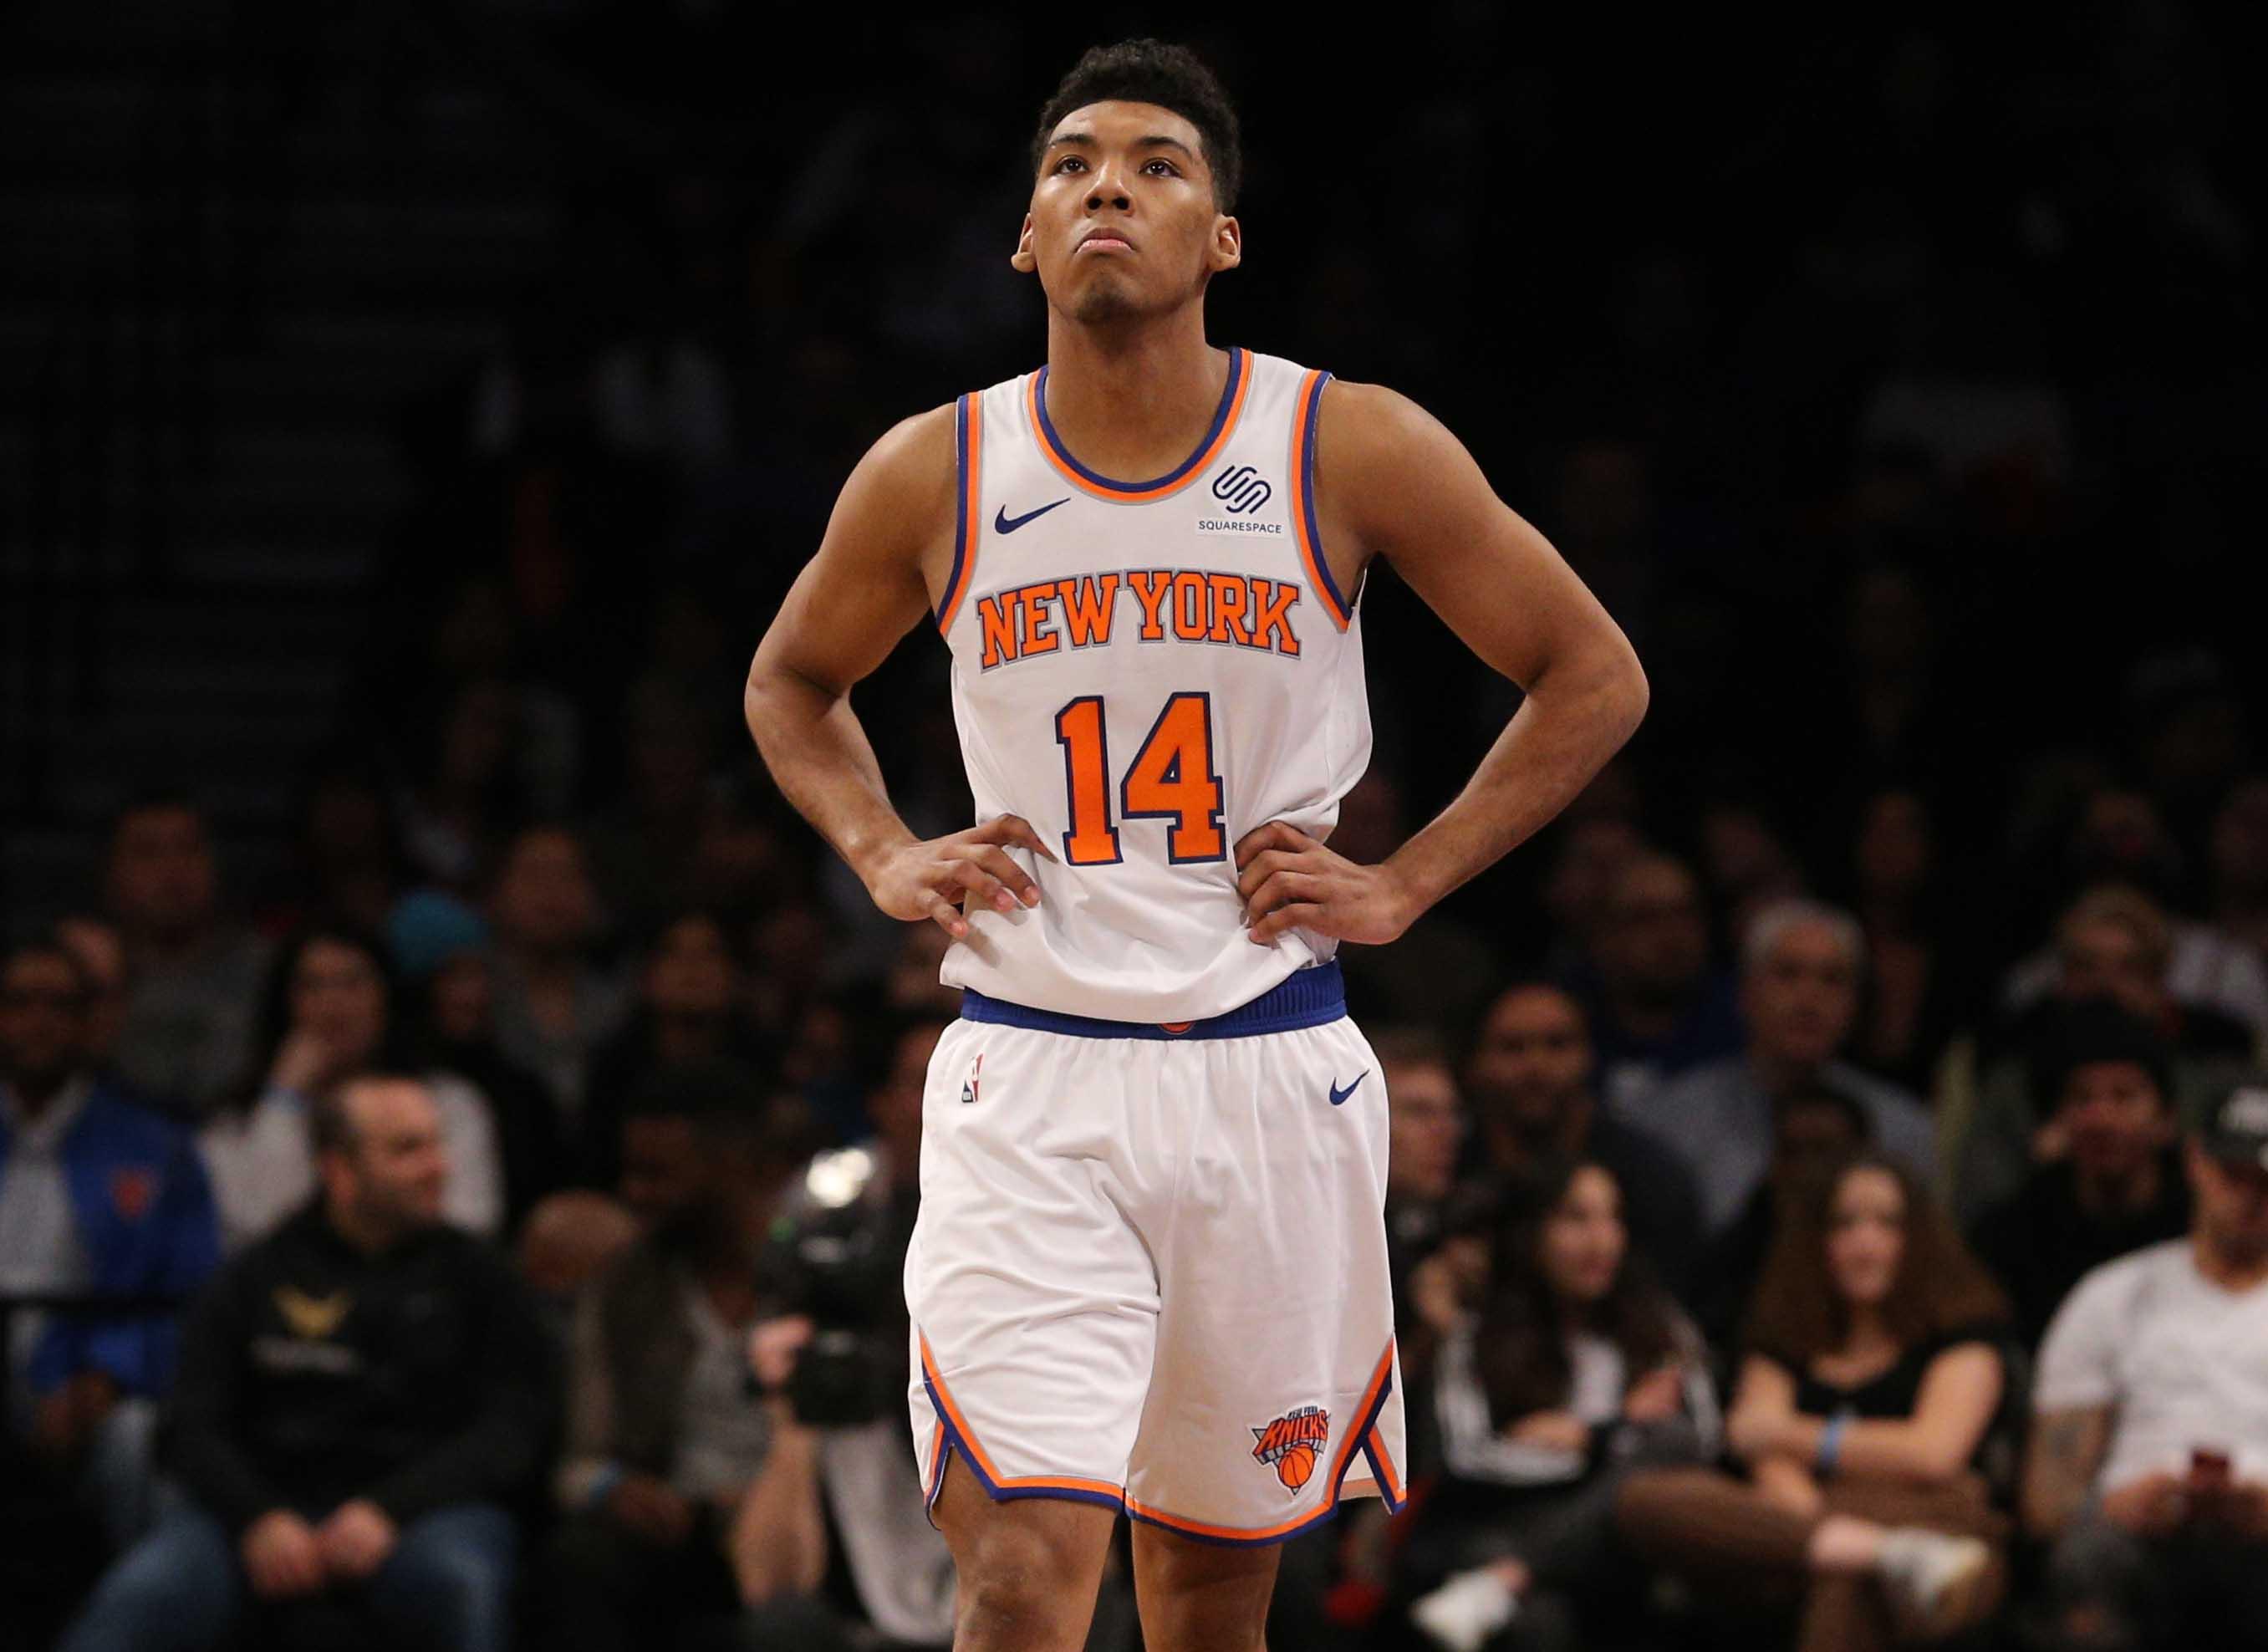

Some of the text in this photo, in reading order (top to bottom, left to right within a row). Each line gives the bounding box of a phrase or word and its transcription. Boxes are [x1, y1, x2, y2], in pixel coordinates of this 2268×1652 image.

[1199, 520, 1282, 533] SQUARESPACE
[976, 569, 1302, 672] NEW YORK
[1054, 691, 1227, 866] 14
[1252, 1410, 1328, 1457] KNICKS
